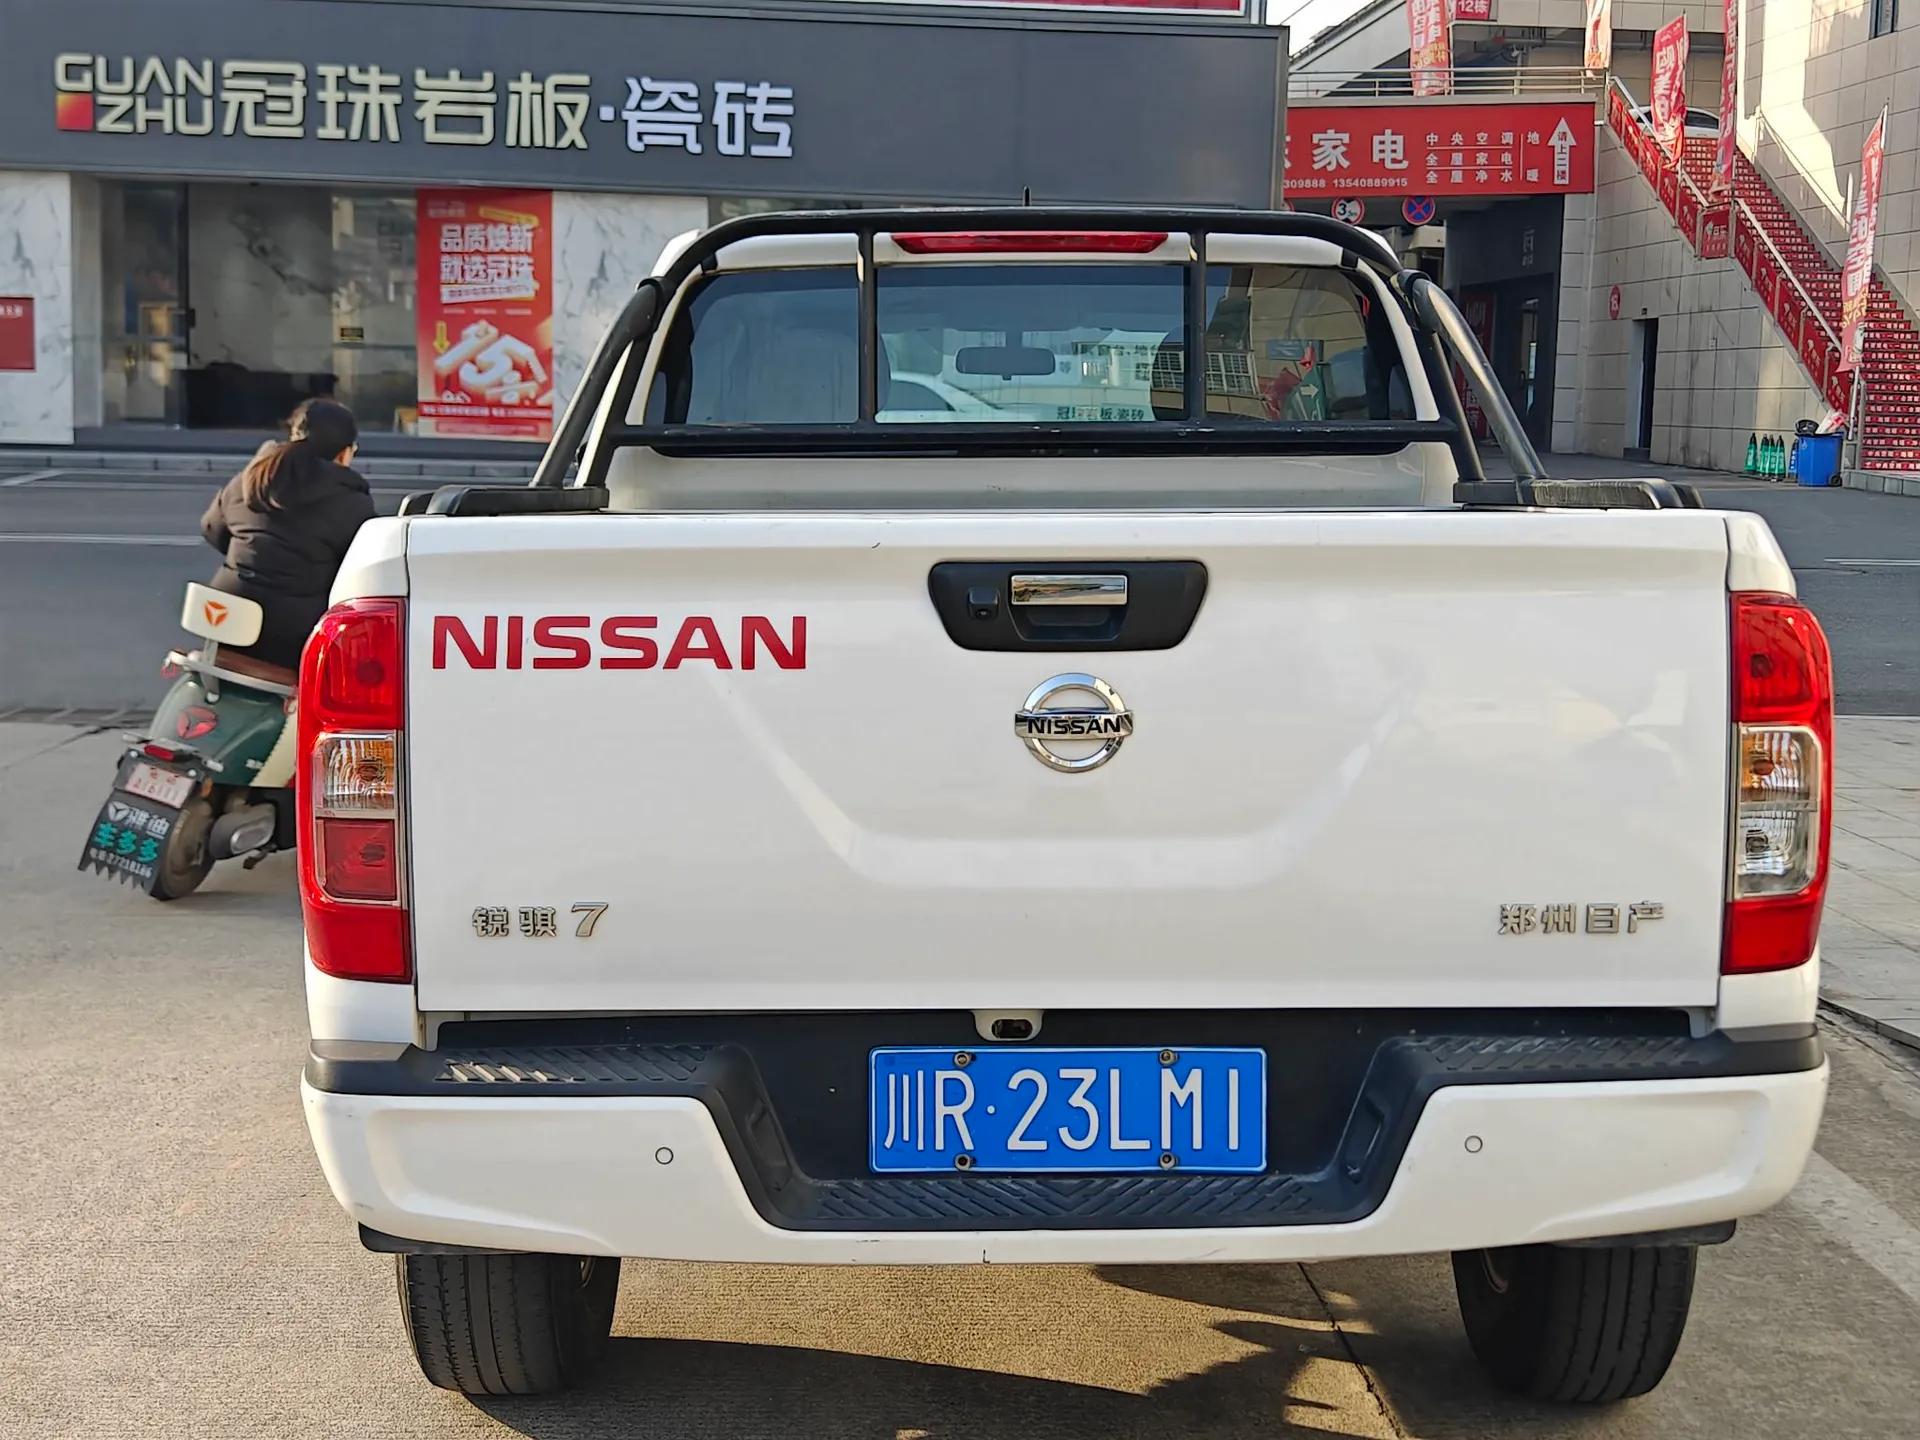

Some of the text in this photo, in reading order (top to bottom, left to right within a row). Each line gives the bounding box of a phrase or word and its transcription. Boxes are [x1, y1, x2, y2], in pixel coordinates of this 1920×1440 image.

[55, 53, 213, 96] GUAN
[96, 94, 214, 135] ZHU
[1283, 129, 1409, 171] 家电
[1426, 132, 1513, 146] 中央空调
[1426, 152, 1513, 166] 全屋家电
[1333, 177, 1408, 188] 13540889915
[1426, 170, 1513, 184] 全屋净水
[433, 615, 807, 670] NISSAN
[1027, 718, 1122, 735] NISSAN
[472, 901, 609, 937] 锐骐 7
[1498, 900, 1664, 934] 郑州日产
